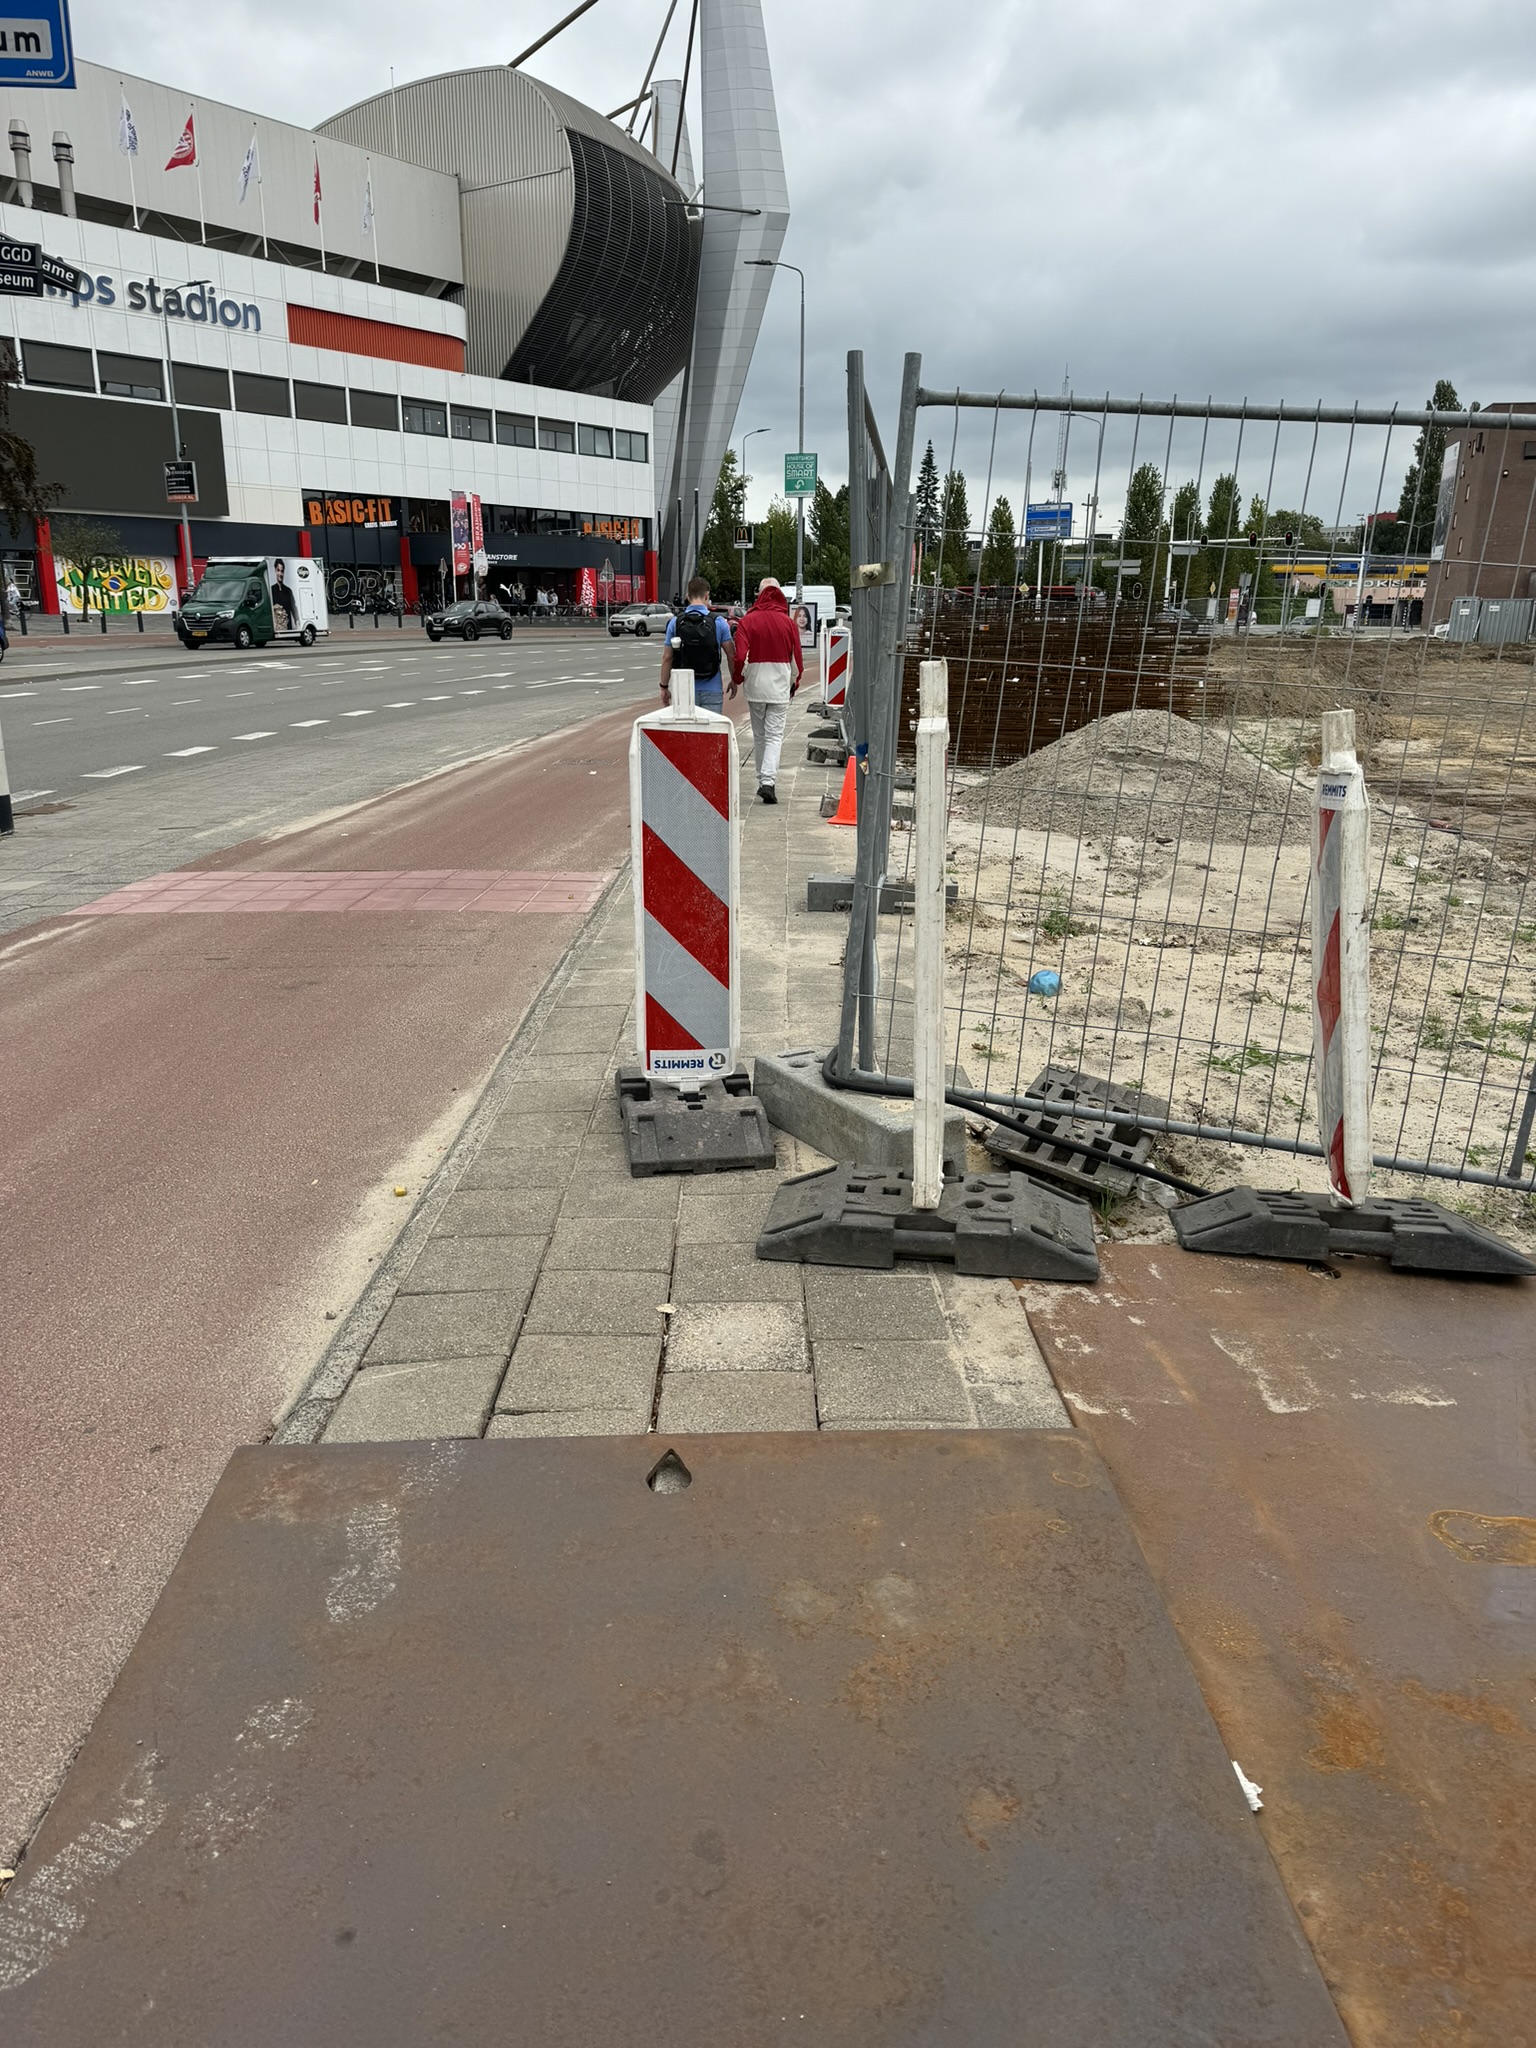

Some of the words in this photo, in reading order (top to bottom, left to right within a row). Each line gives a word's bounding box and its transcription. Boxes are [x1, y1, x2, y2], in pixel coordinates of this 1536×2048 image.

[26, 69, 54, 77] ANWB
[1, 246, 31, 262] GGD
[128, 277, 262, 332] stadion
[786, 469, 814, 478] SMART
[654, 1059, 704, 1069] REMMITS
